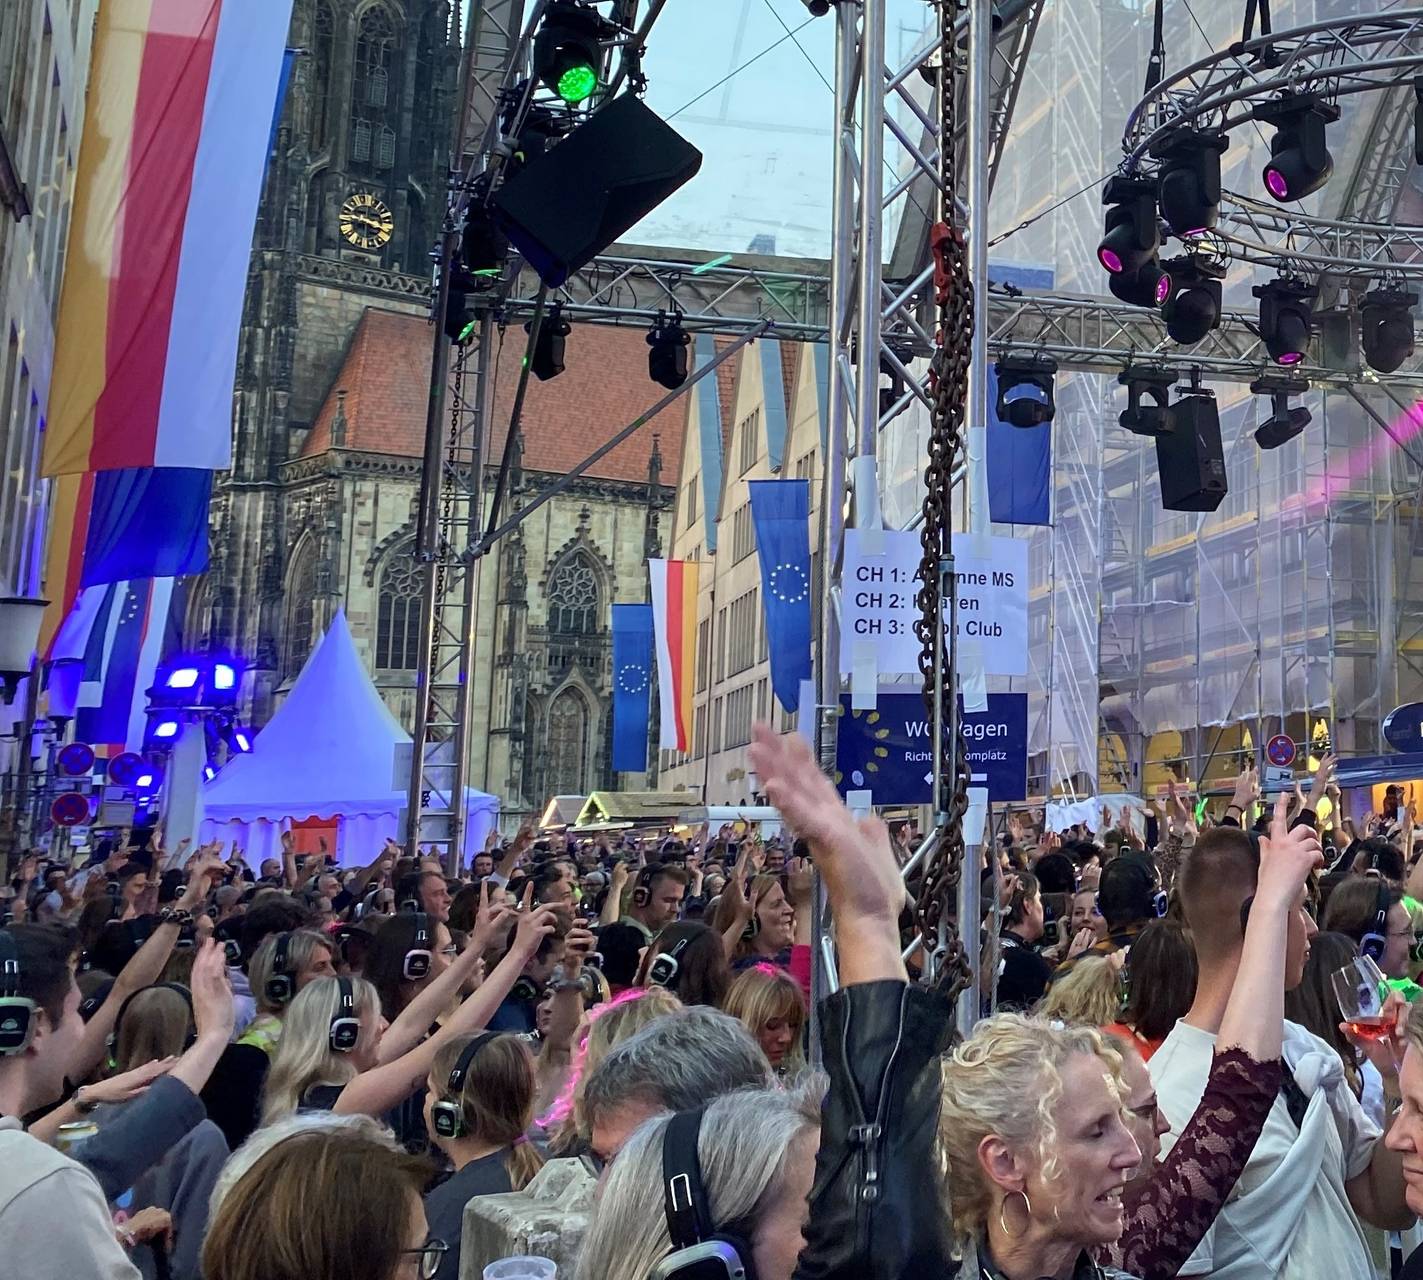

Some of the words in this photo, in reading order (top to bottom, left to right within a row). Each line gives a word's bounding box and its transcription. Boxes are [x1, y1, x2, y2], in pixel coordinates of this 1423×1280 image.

[857, 566, 883, 582] CH
[890, 568, 906, 582] 1:
[912, 569, 987, 585] Anne
[992, 571, 1014, 587] MS
[855, 592, 882, 608] CH
[888, 593, 905, 608] 2:
[854, 619, 881, 634] CH
[888, 619, 904, 634] 3:
[966, 620, 1002, 636] Club
[957, 751, 1007, 763] omplatz
